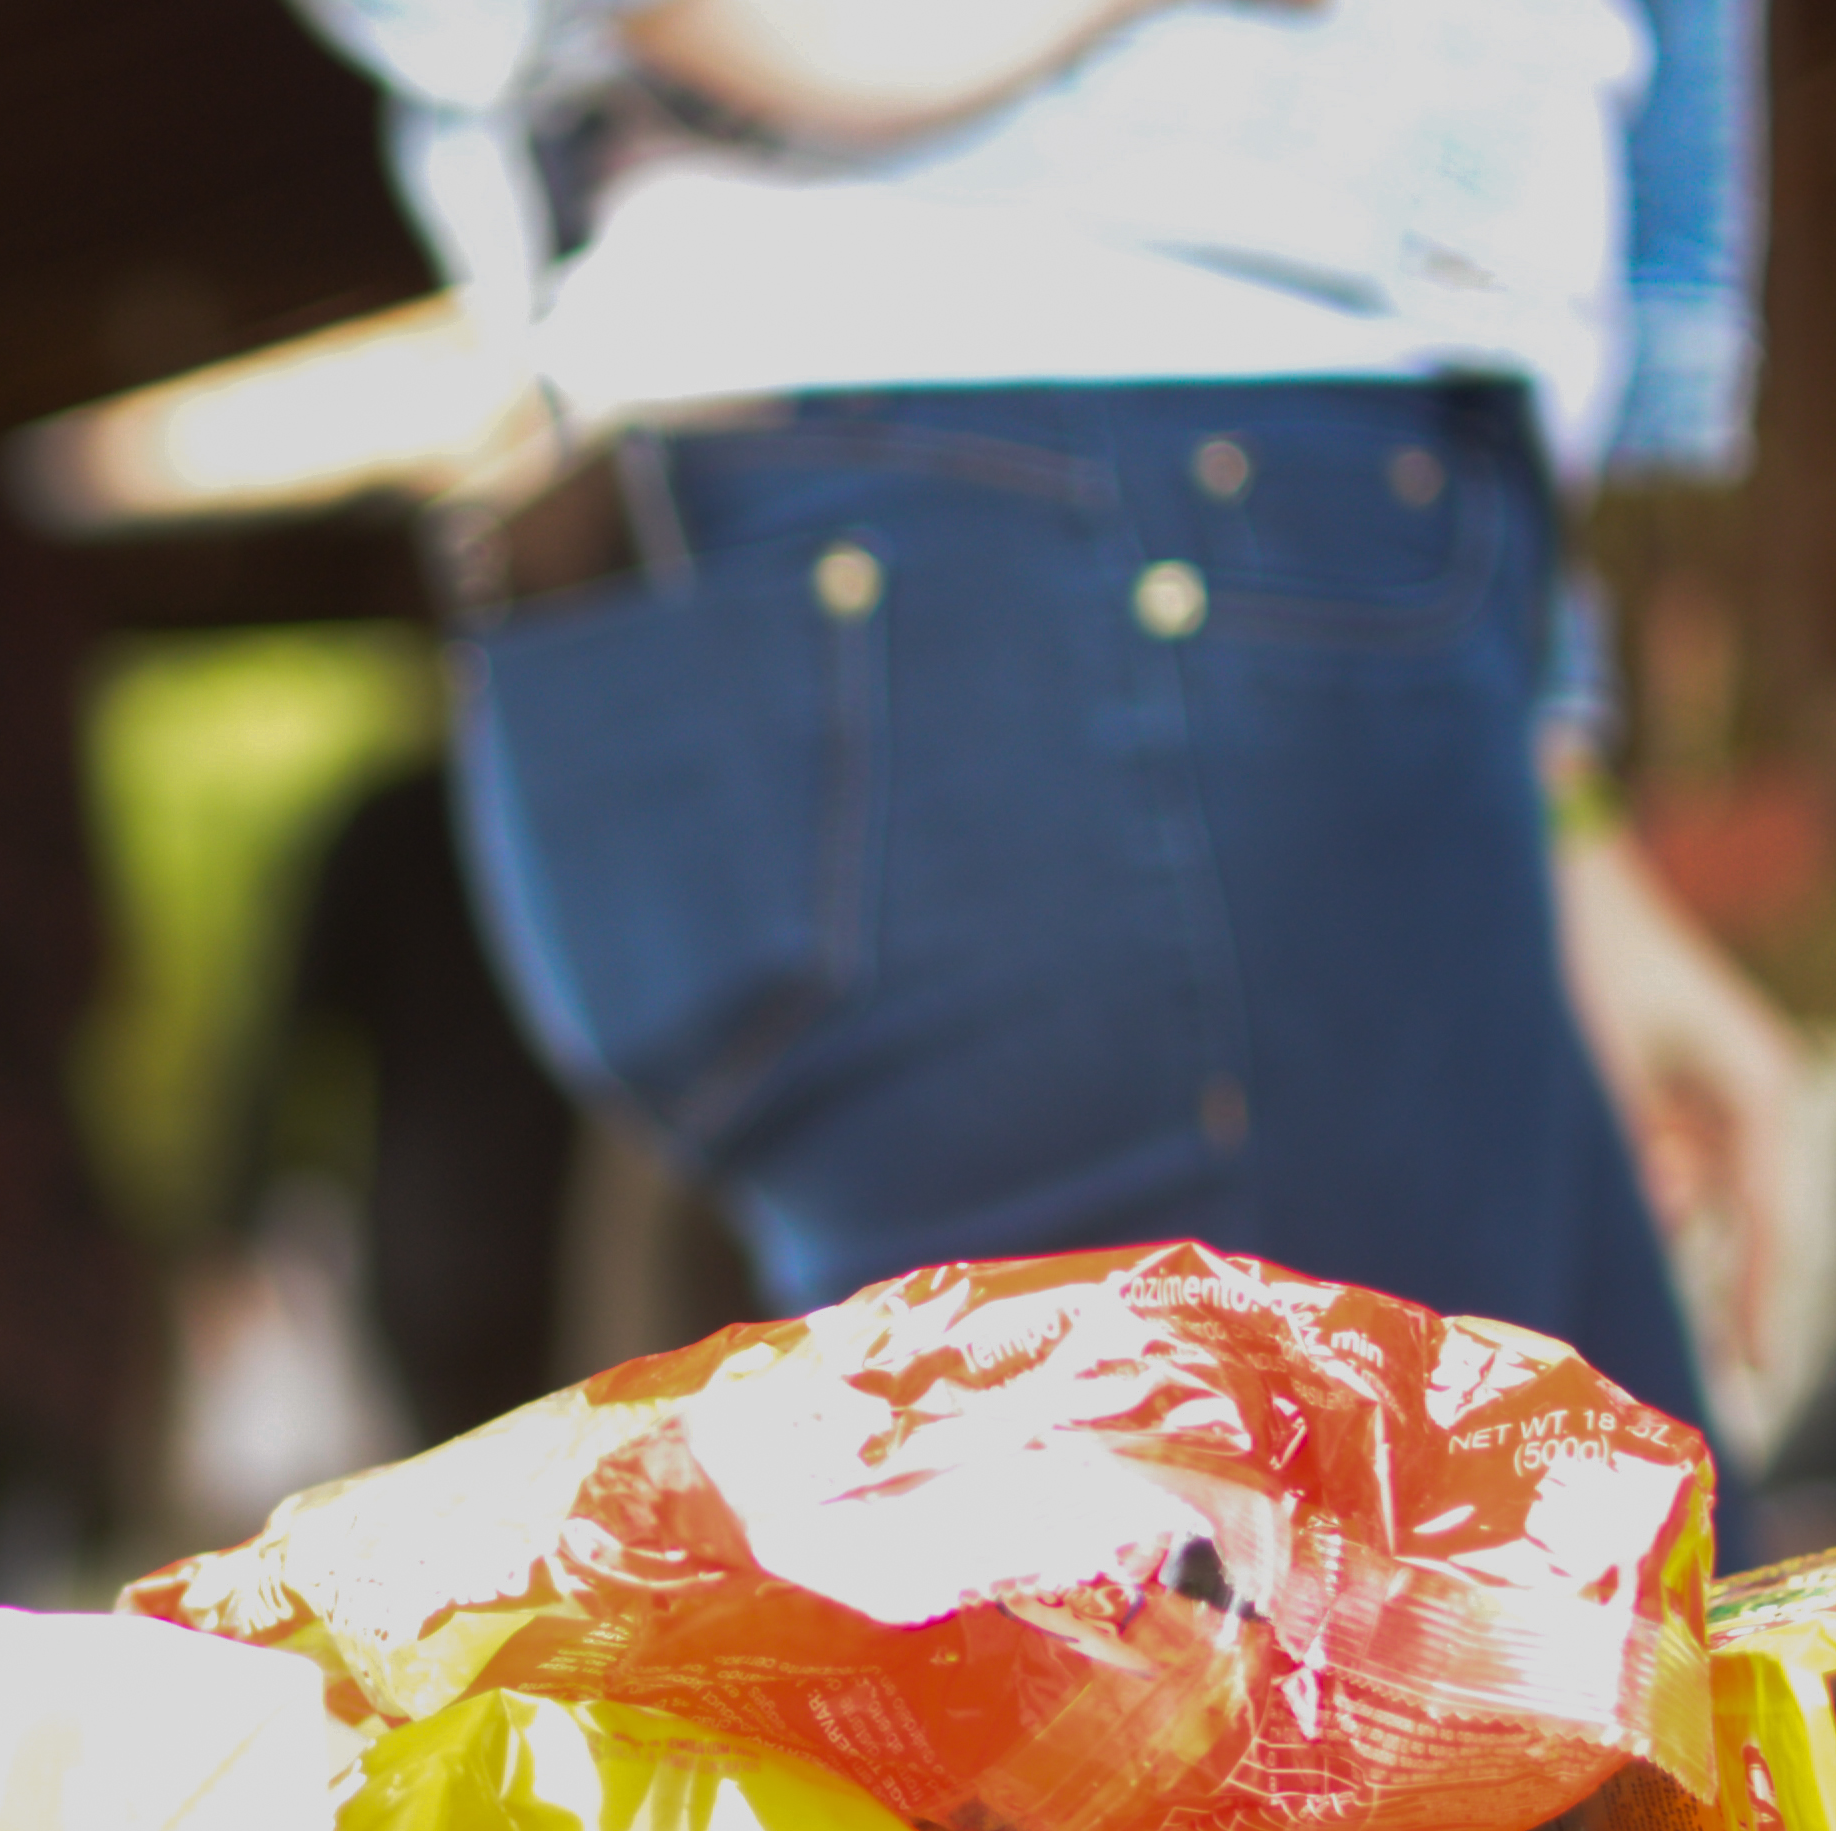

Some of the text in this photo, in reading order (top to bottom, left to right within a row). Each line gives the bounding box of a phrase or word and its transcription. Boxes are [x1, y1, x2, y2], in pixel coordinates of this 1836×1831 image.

[958, 1318, 1060, 1375] Tempo
[1331, 1331, 1384, 1369] min
[1448, 1424, 1513, 1455] NET
[1520, 1410, 1568, 1438] WT.
[1583, 1409, 1617, 1431] 18
